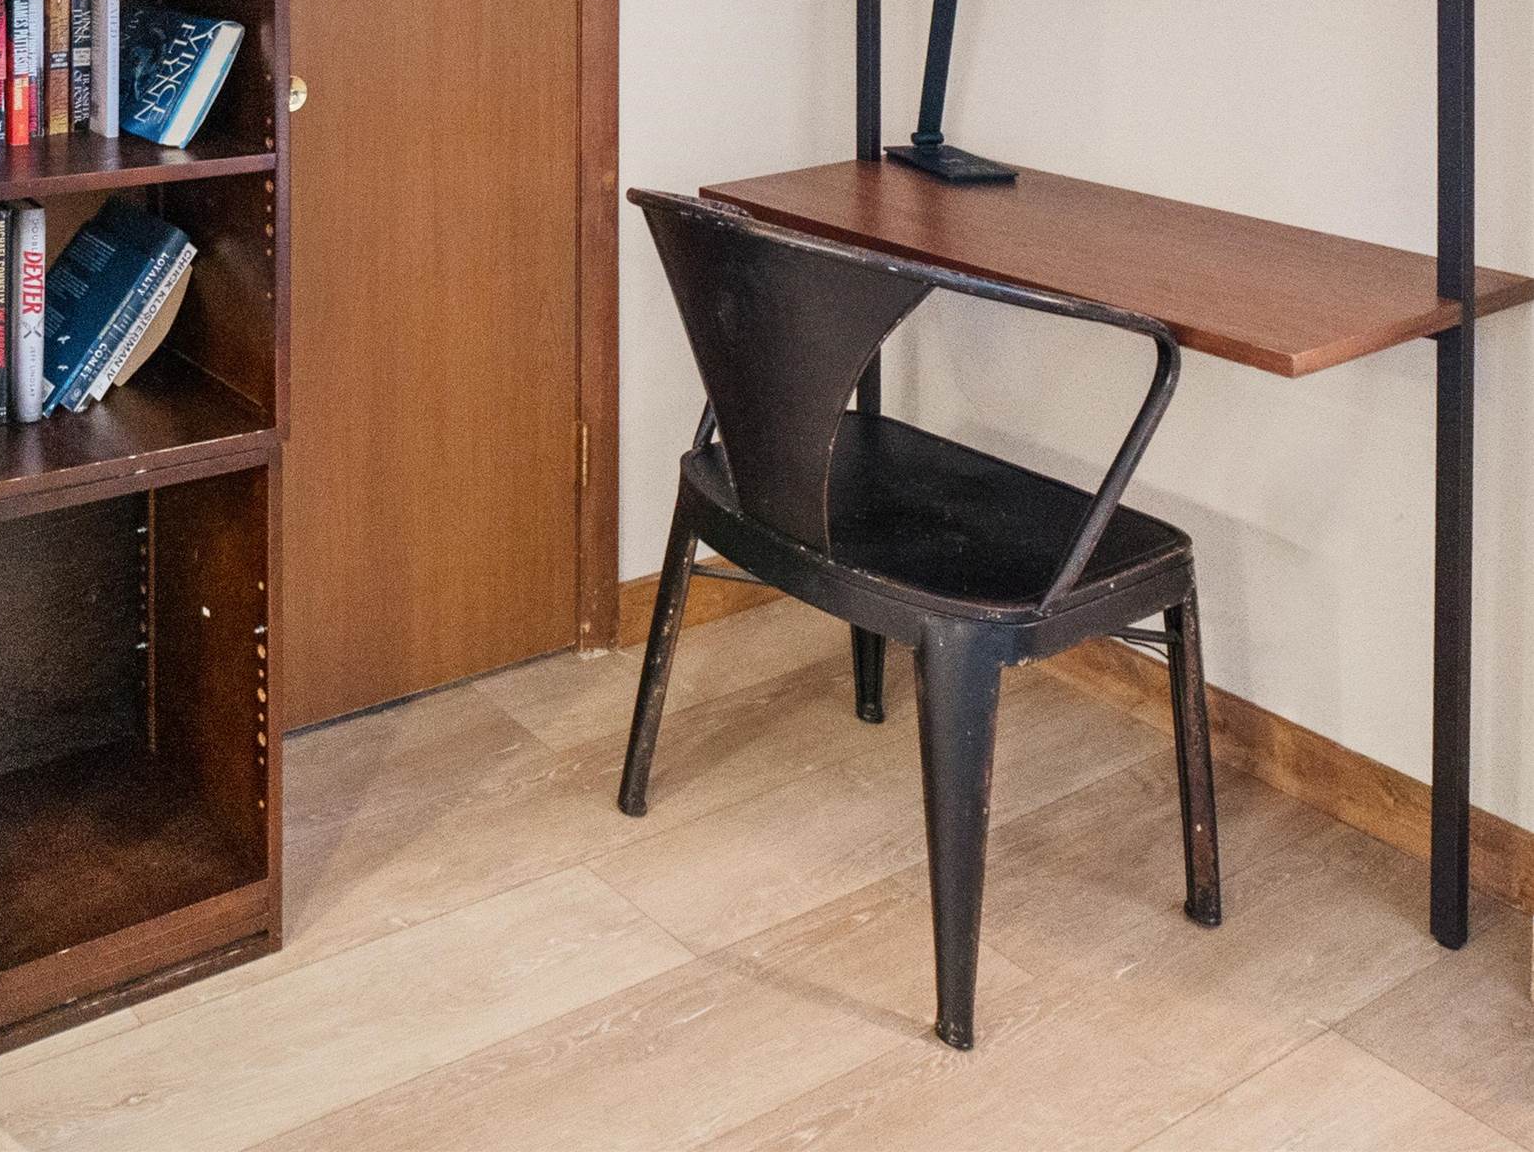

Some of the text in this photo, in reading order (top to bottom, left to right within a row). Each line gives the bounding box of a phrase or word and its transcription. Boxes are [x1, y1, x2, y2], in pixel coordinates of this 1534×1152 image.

[13, 0, 29, 28] JAMES
[13, 29, 29, 76] PATTERSON
[133, 23, 196, 122] FLYNN
[148, 31, 214, 125] VINCE
[22, 250, 45, 315] DEXTER
[137, 252, 170, 297] LOYALTY
[164, 249, 192, 290] CHUCK
[113, 290, 167, 368] KLOSTERMAN
[80, 343, 108, 381] COMEY
